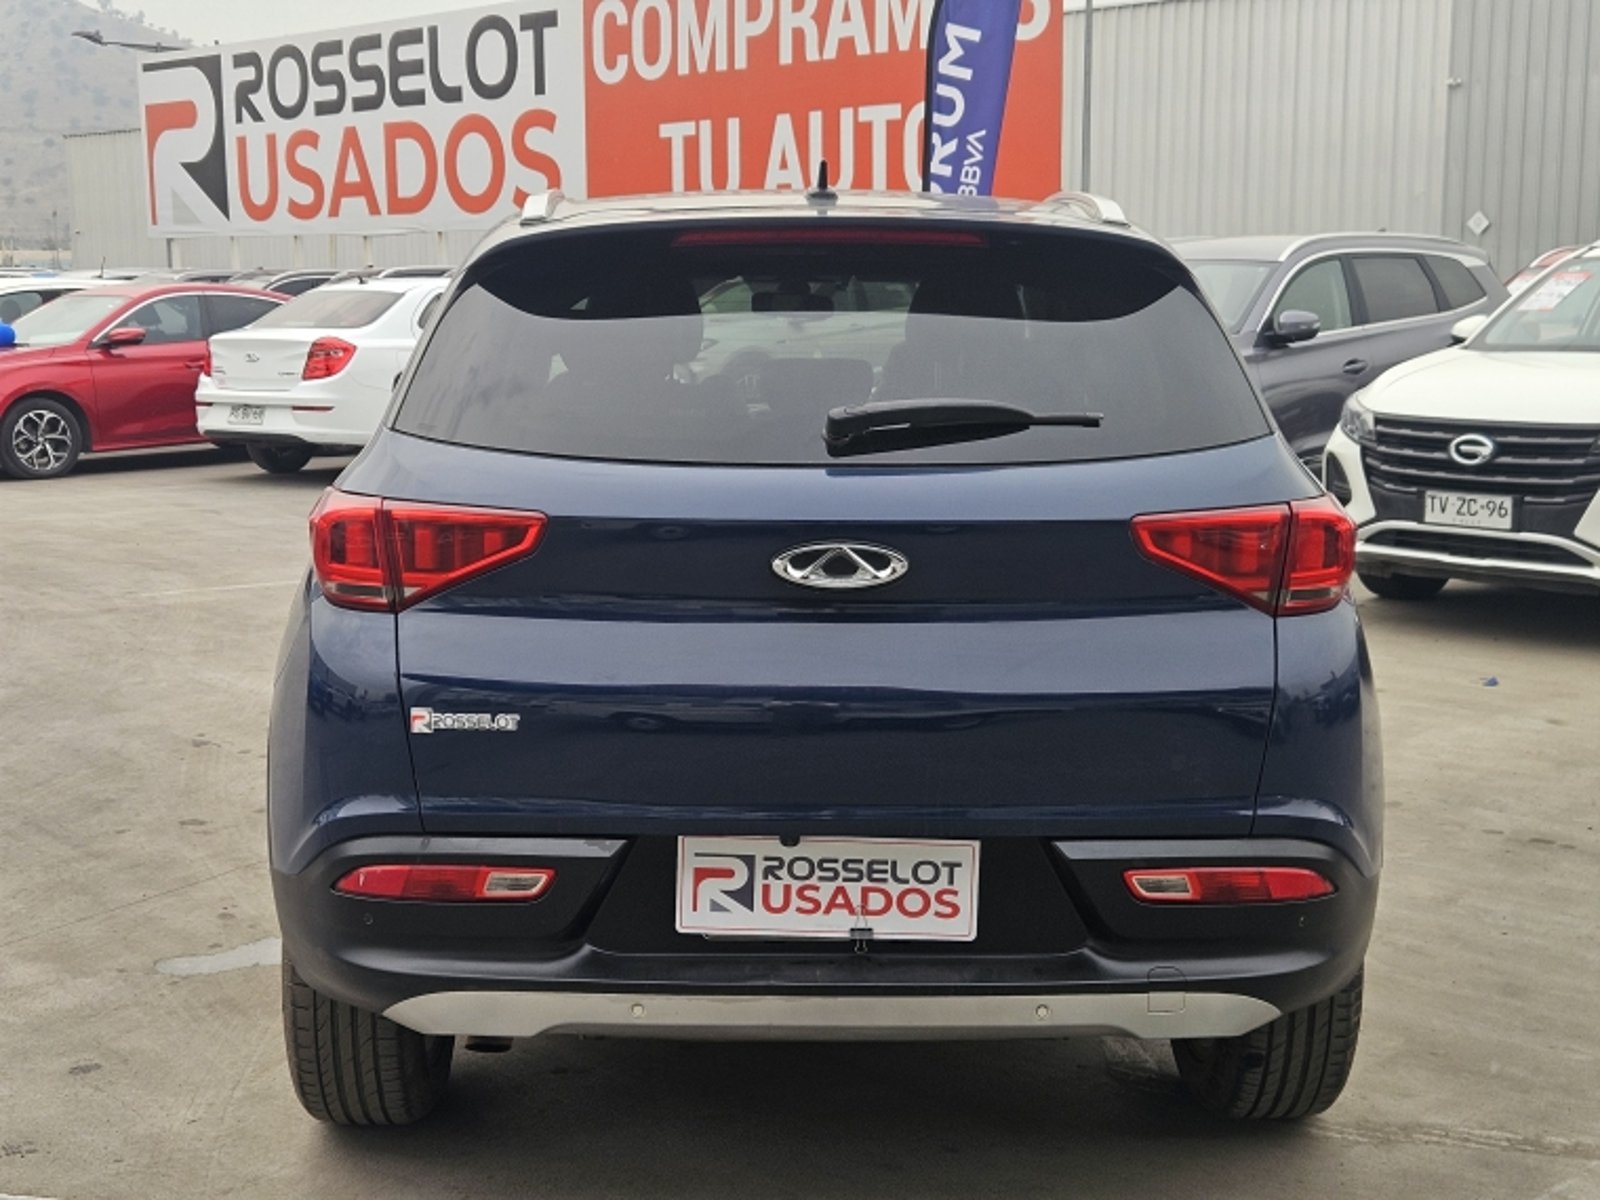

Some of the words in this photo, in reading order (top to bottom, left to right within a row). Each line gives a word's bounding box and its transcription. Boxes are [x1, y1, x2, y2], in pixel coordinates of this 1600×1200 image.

[232, 9, 558, 124] ROSSELOT
[235, 108, 562, 222] USADOS
[658, 117, 741, 192] TU
[433, 713, 521, 731] ROSSELOT
[762, 856, 963, 886] ROSSELOT
[761, 884, 961, 919] USADOS
